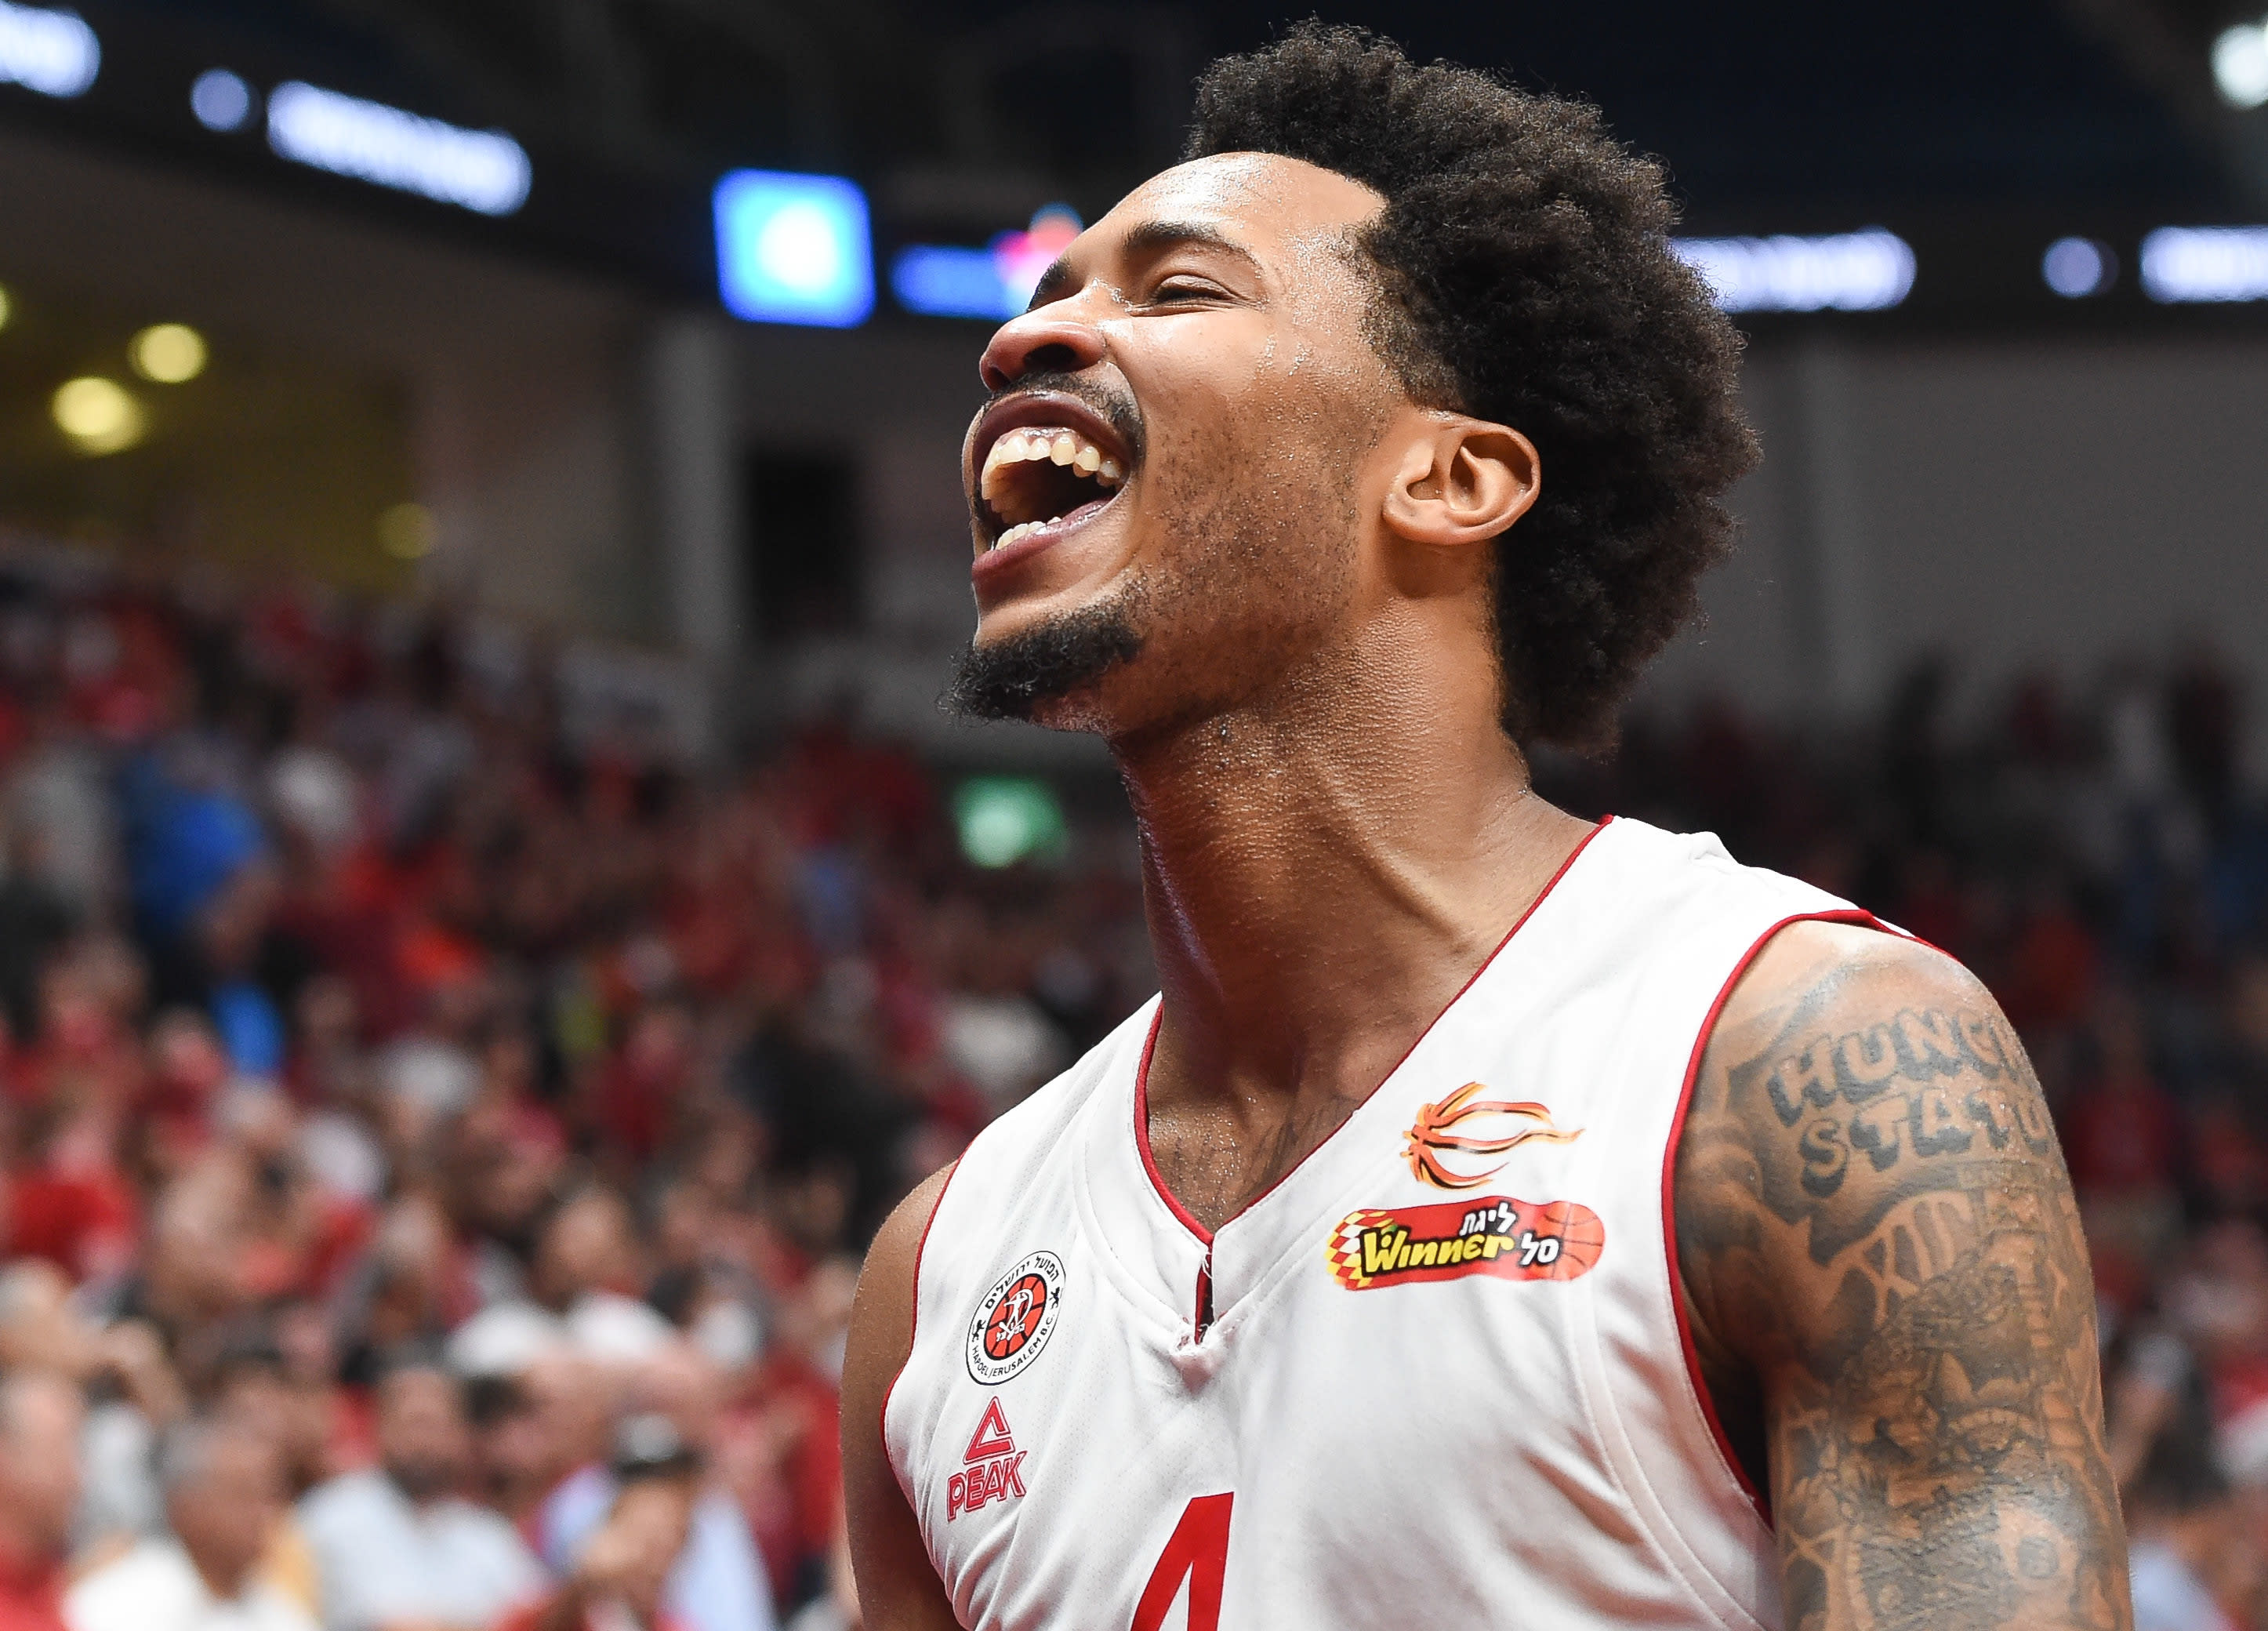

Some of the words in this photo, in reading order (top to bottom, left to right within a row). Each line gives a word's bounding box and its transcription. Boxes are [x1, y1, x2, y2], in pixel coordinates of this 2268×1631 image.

[1459, 1201, 1517, 1237] ליגת
[1034, 1255, 1059, 1282] הפועל
[1363, 1228, 1515, 1273] Winner
[1519, 1232, 1560, 1266] סל
[985, 1261, 1030, 1310] ירושלים
[972, 1345, 990, 1376] HAPOEL
[987, 1337, 1041, 1379] JERUSALEM
[946, 1451, 1028, 1523] PEAK
